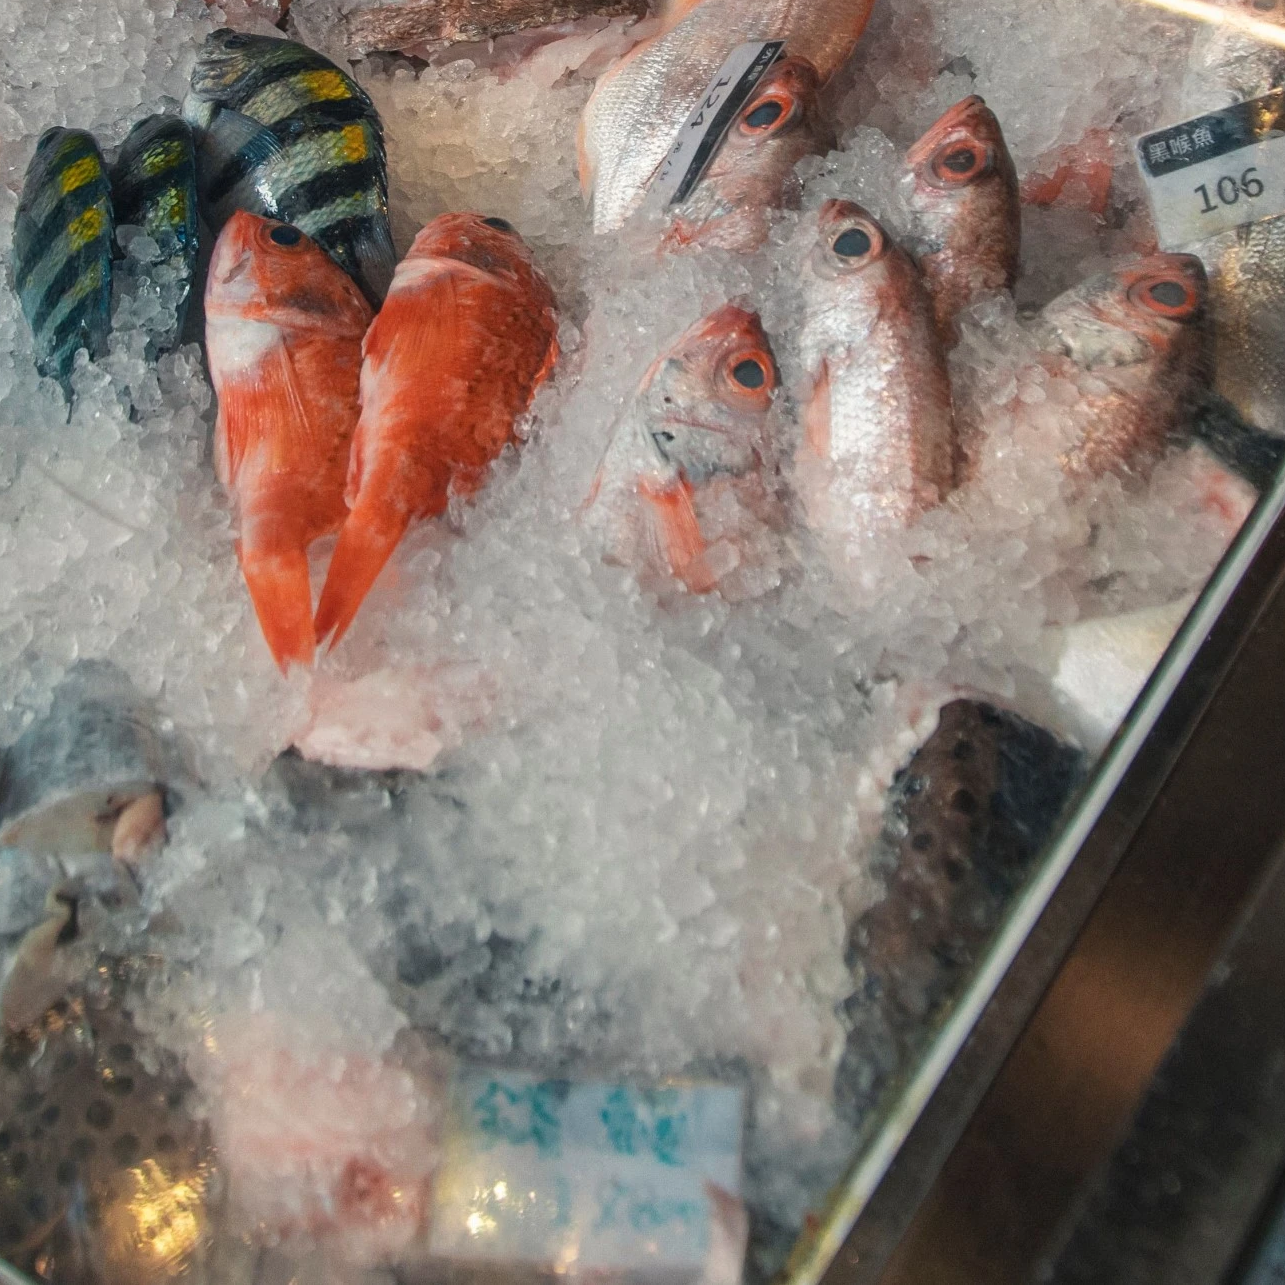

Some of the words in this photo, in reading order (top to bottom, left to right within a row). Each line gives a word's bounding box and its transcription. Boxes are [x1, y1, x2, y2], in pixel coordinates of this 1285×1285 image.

[690, 76, 731, 129] 124
[1148, 125, 1215, 164] 黑喉魚
[1194, 167, 1265, 214] 106
